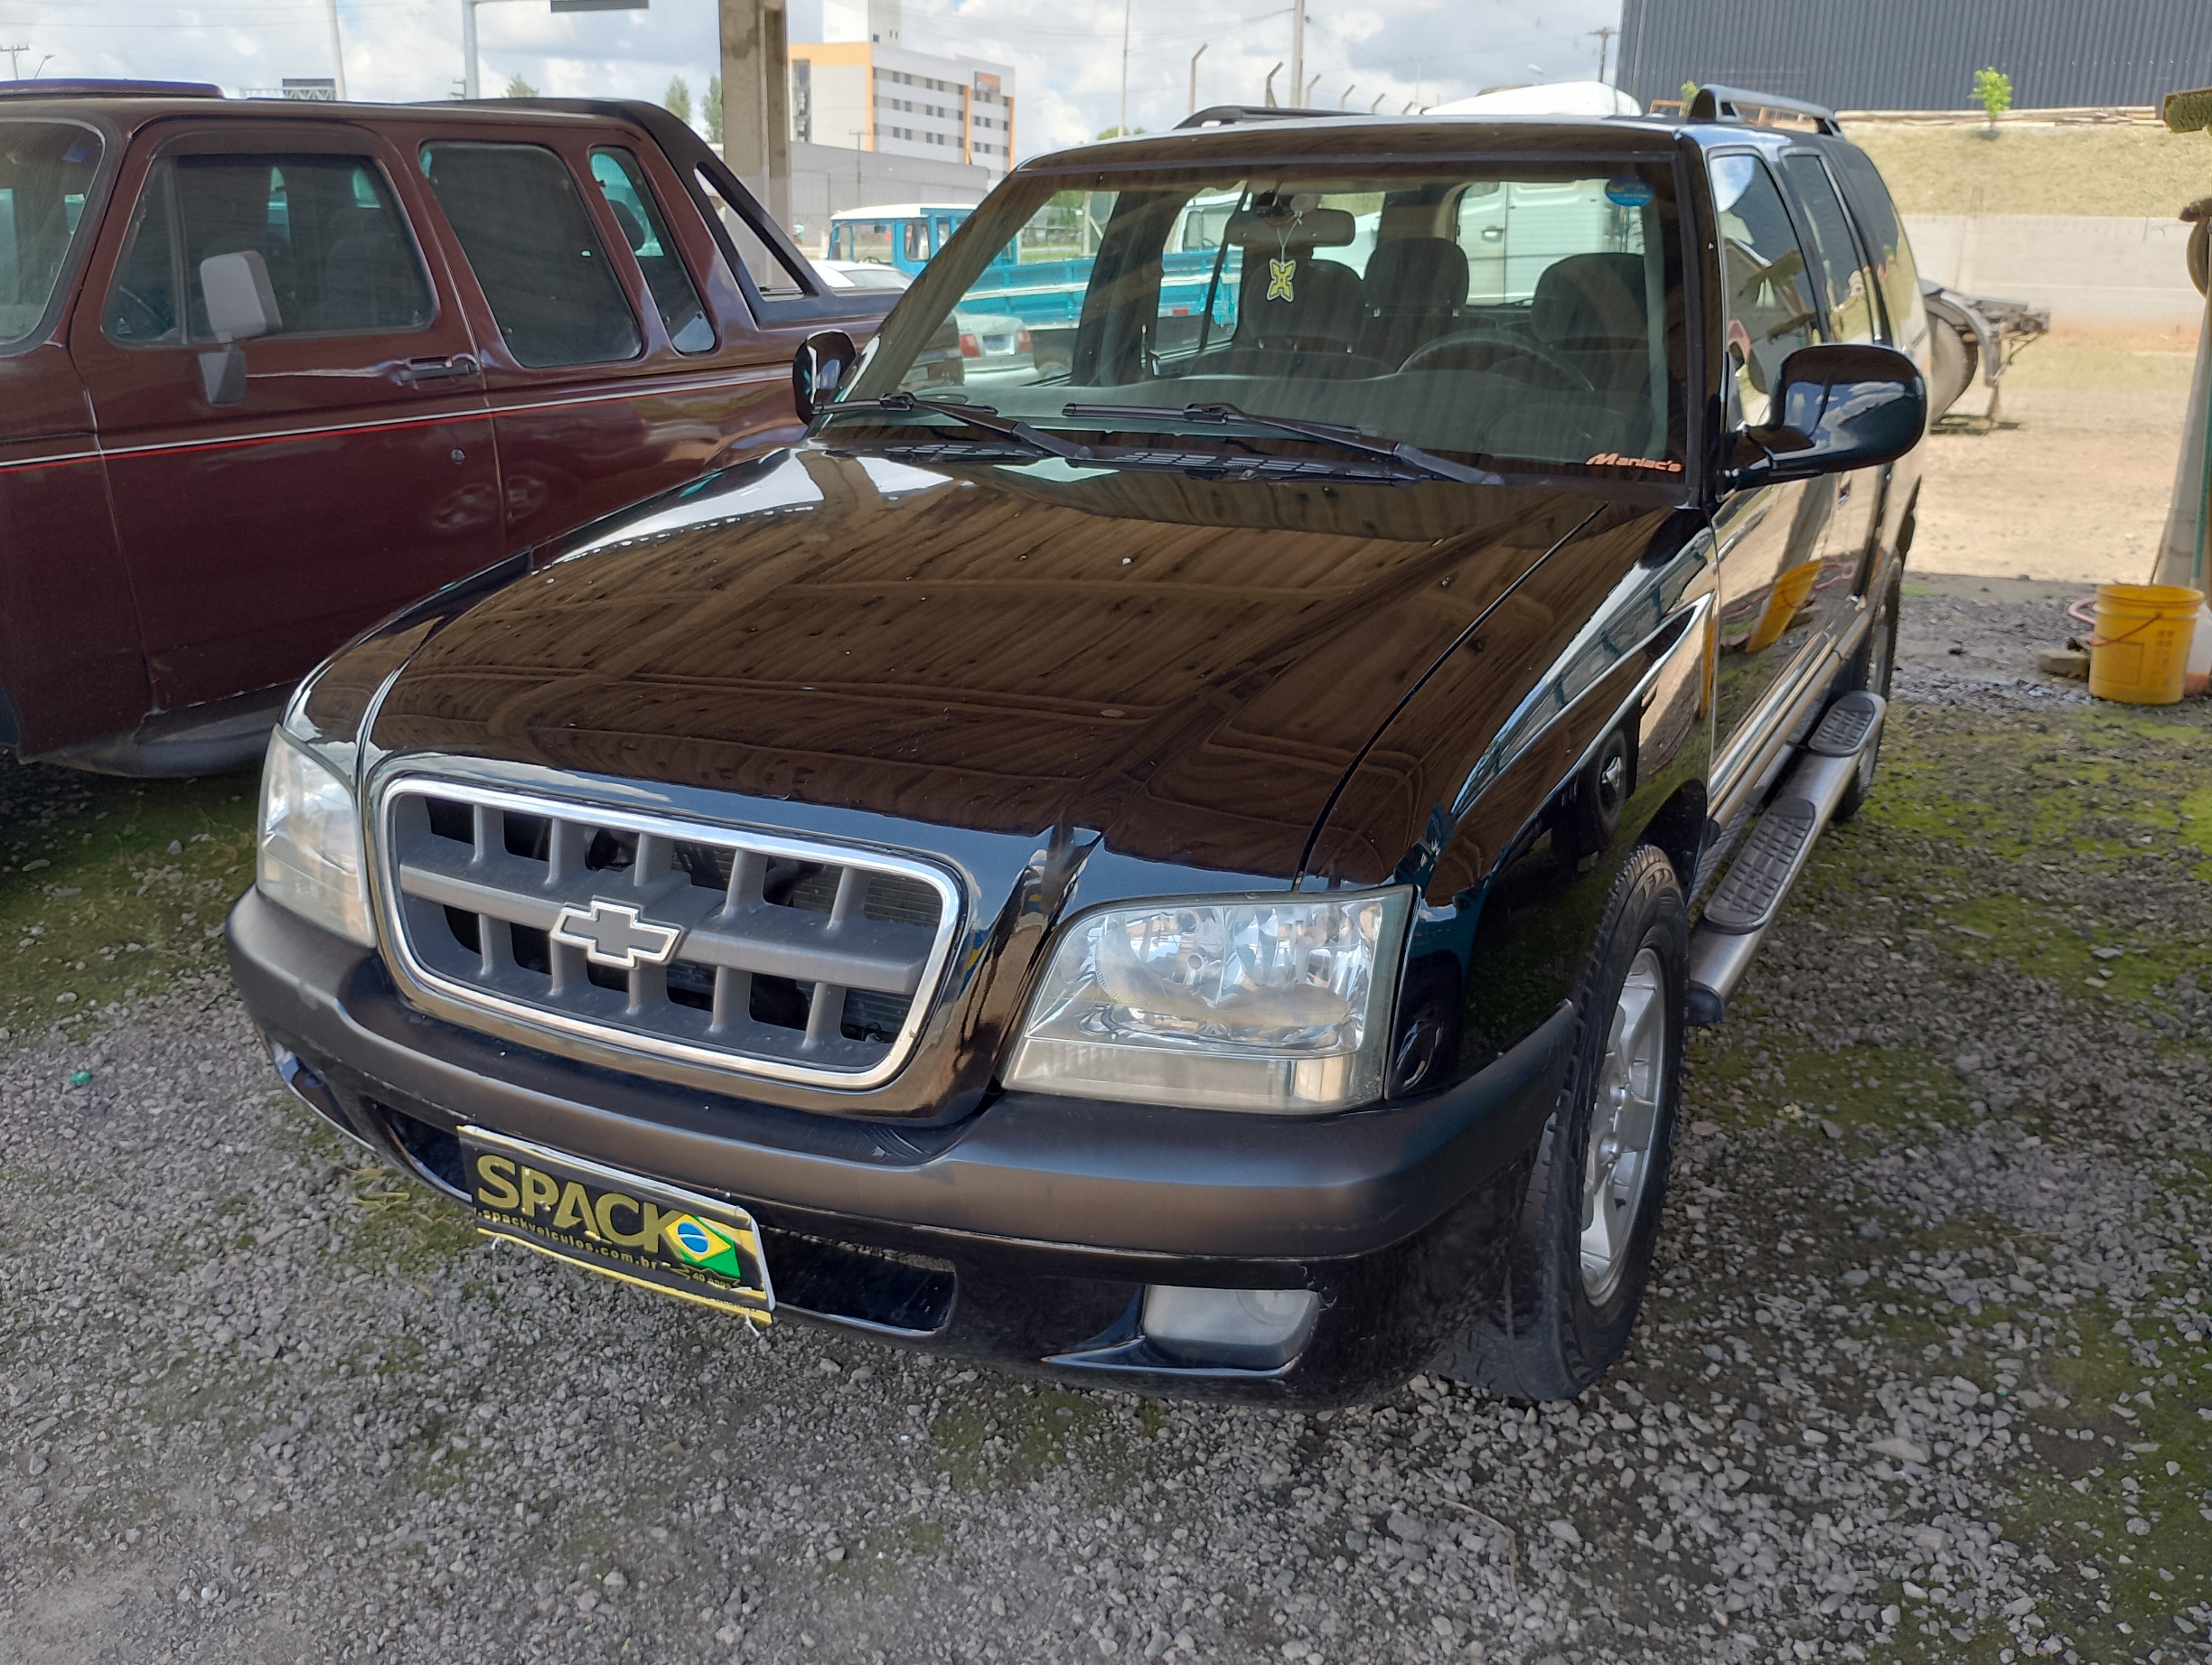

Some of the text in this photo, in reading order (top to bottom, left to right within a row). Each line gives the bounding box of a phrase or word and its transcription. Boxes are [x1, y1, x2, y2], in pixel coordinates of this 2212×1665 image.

[1585, 453, 1682, 472] Maniac's
[475, 1154, 685, 1262] SPACK
[692, 1272, 707, 1283] 40
